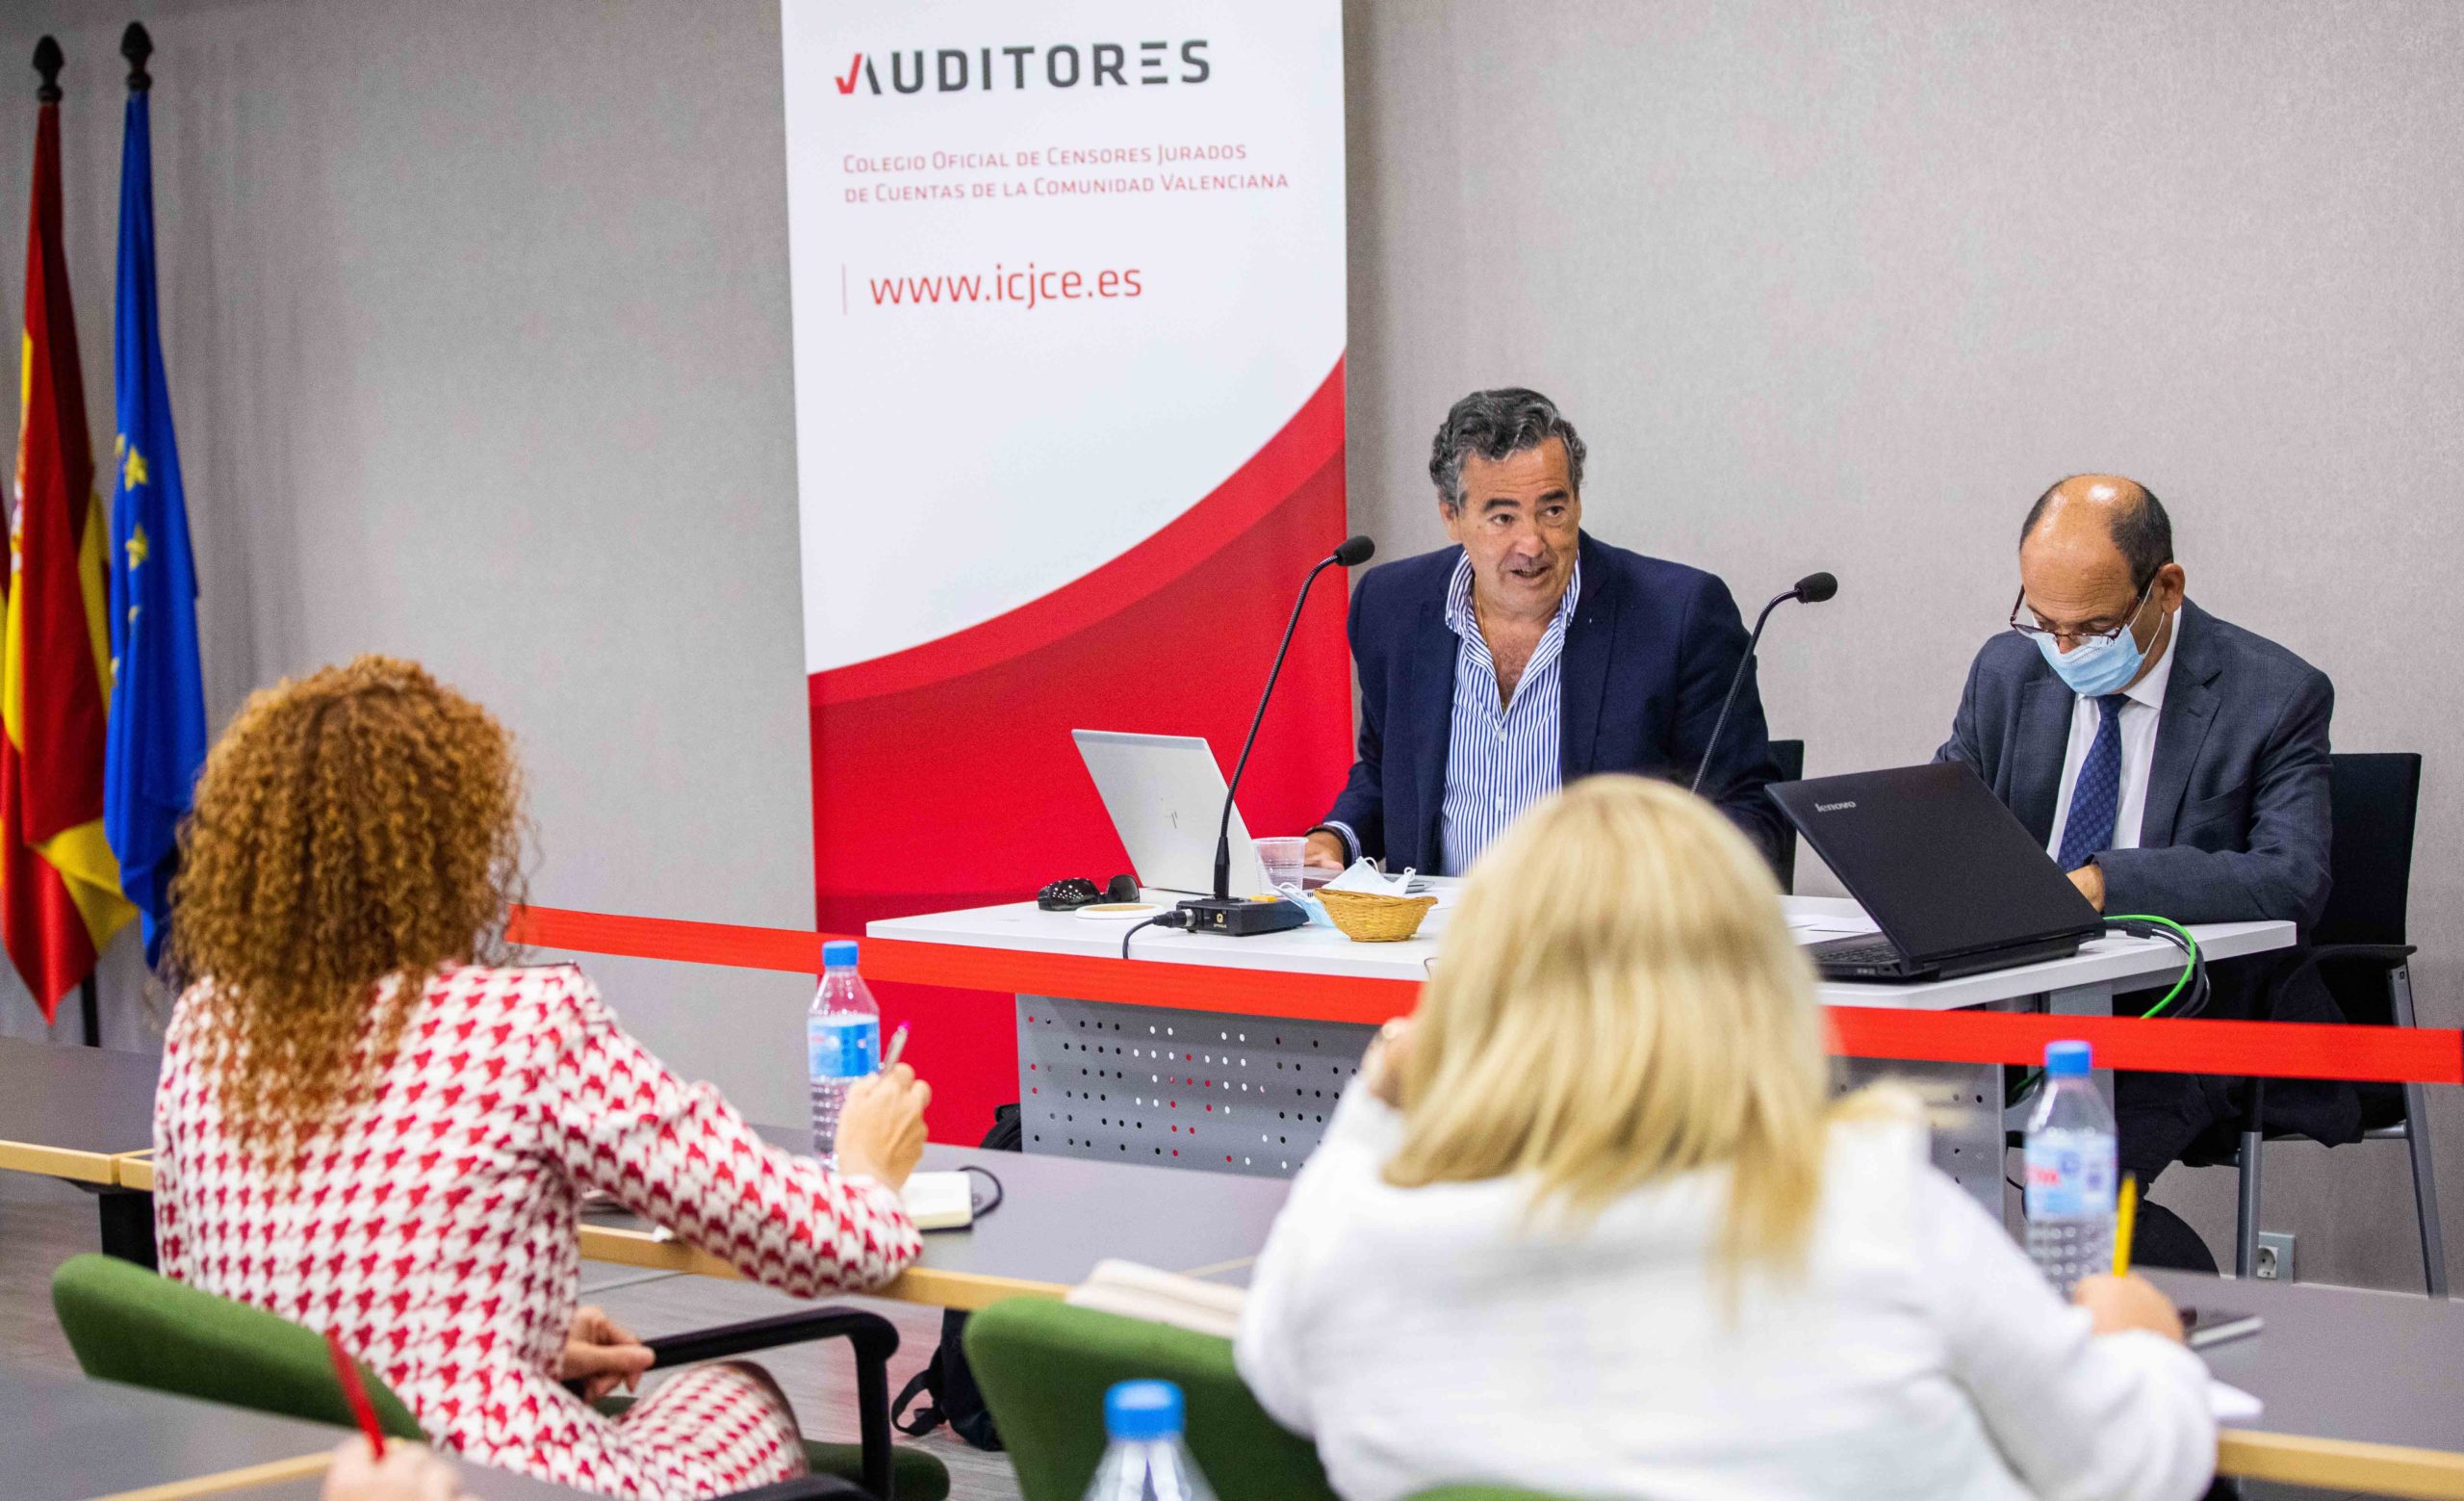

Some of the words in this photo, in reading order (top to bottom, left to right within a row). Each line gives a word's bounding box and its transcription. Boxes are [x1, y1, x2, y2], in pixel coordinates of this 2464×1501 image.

[835, 39, 1210, 94] AUDITORES
[1016, 151, 1040, 167] DE
[845, 188, 869, 203] DE
[971, 183, 996, 198] DE
[1003, 182, 1028, 197] LA
[870, 263, 1142, 309] www.icjce.es
